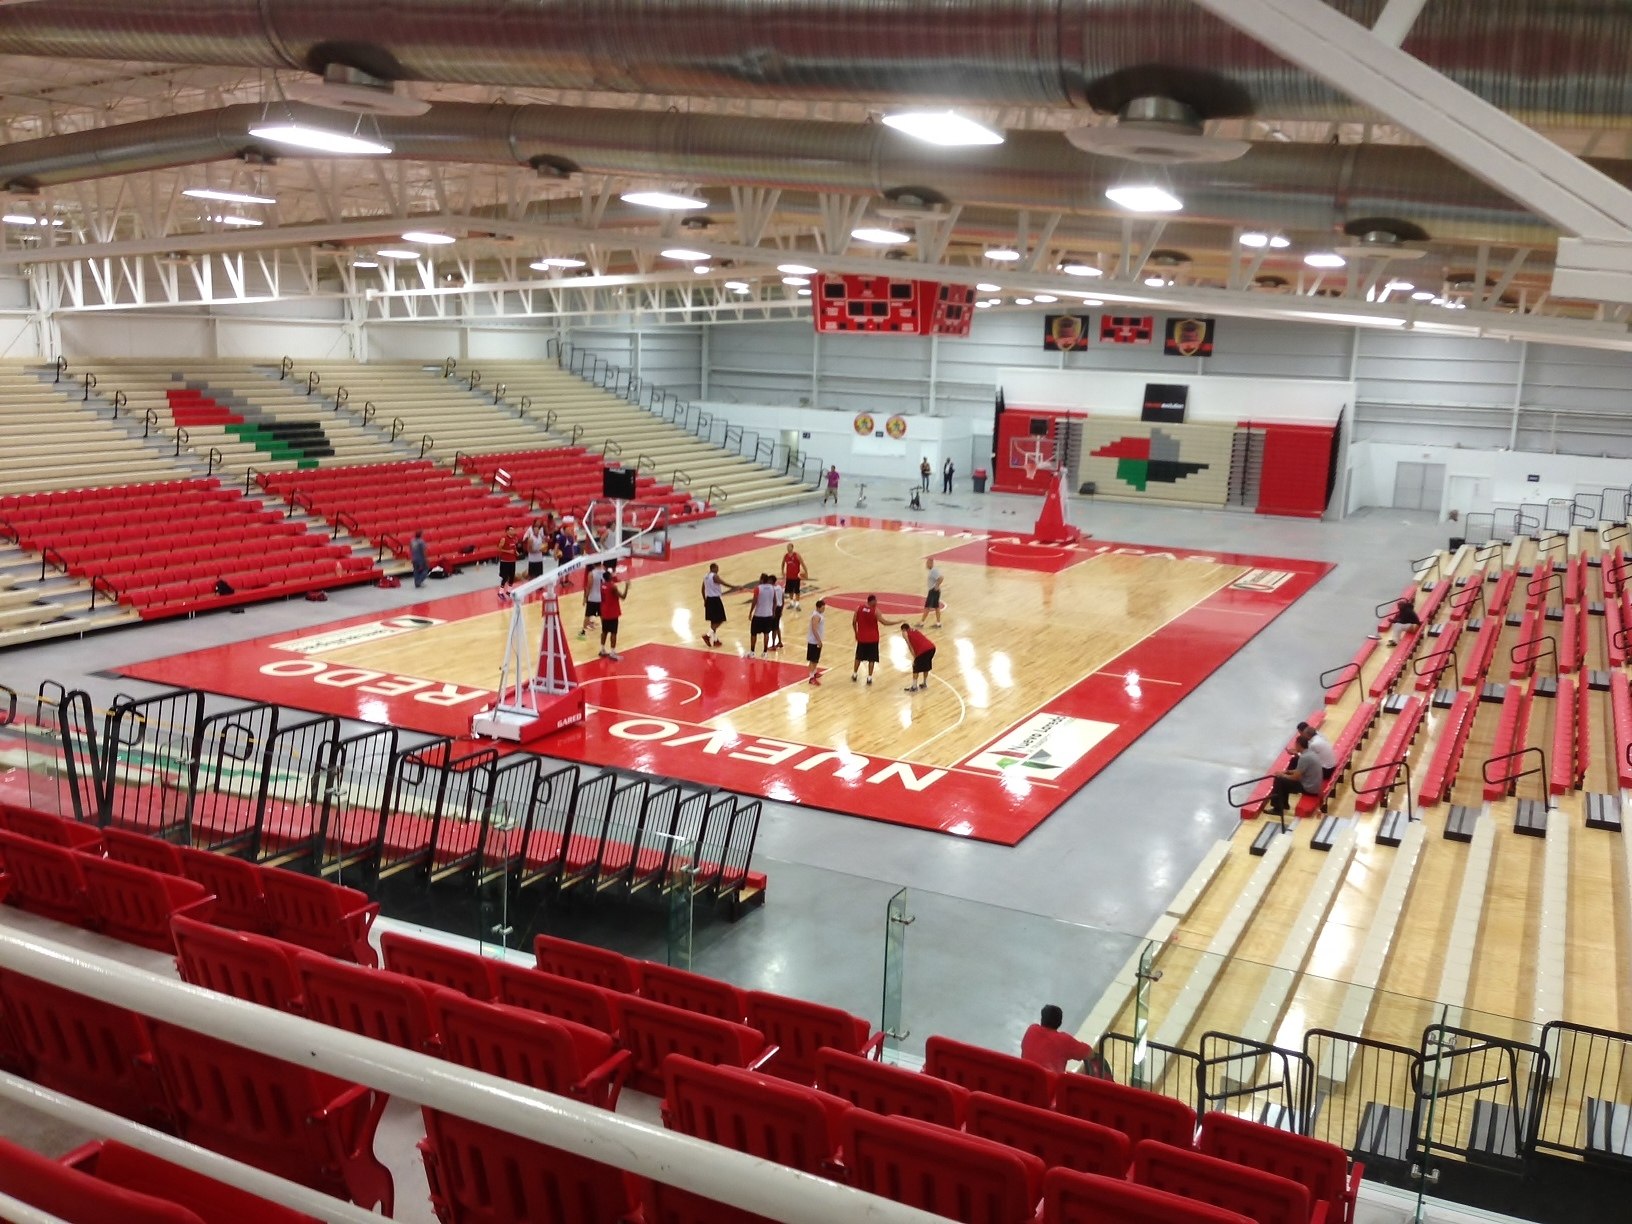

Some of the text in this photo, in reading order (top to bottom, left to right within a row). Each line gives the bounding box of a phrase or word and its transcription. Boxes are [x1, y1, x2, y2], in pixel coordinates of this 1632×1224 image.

[557, 712, 582, 728] GARED
[1007, 732, 1042, 751] Nuevo
[608, 719, 949, 792] NUEVO
